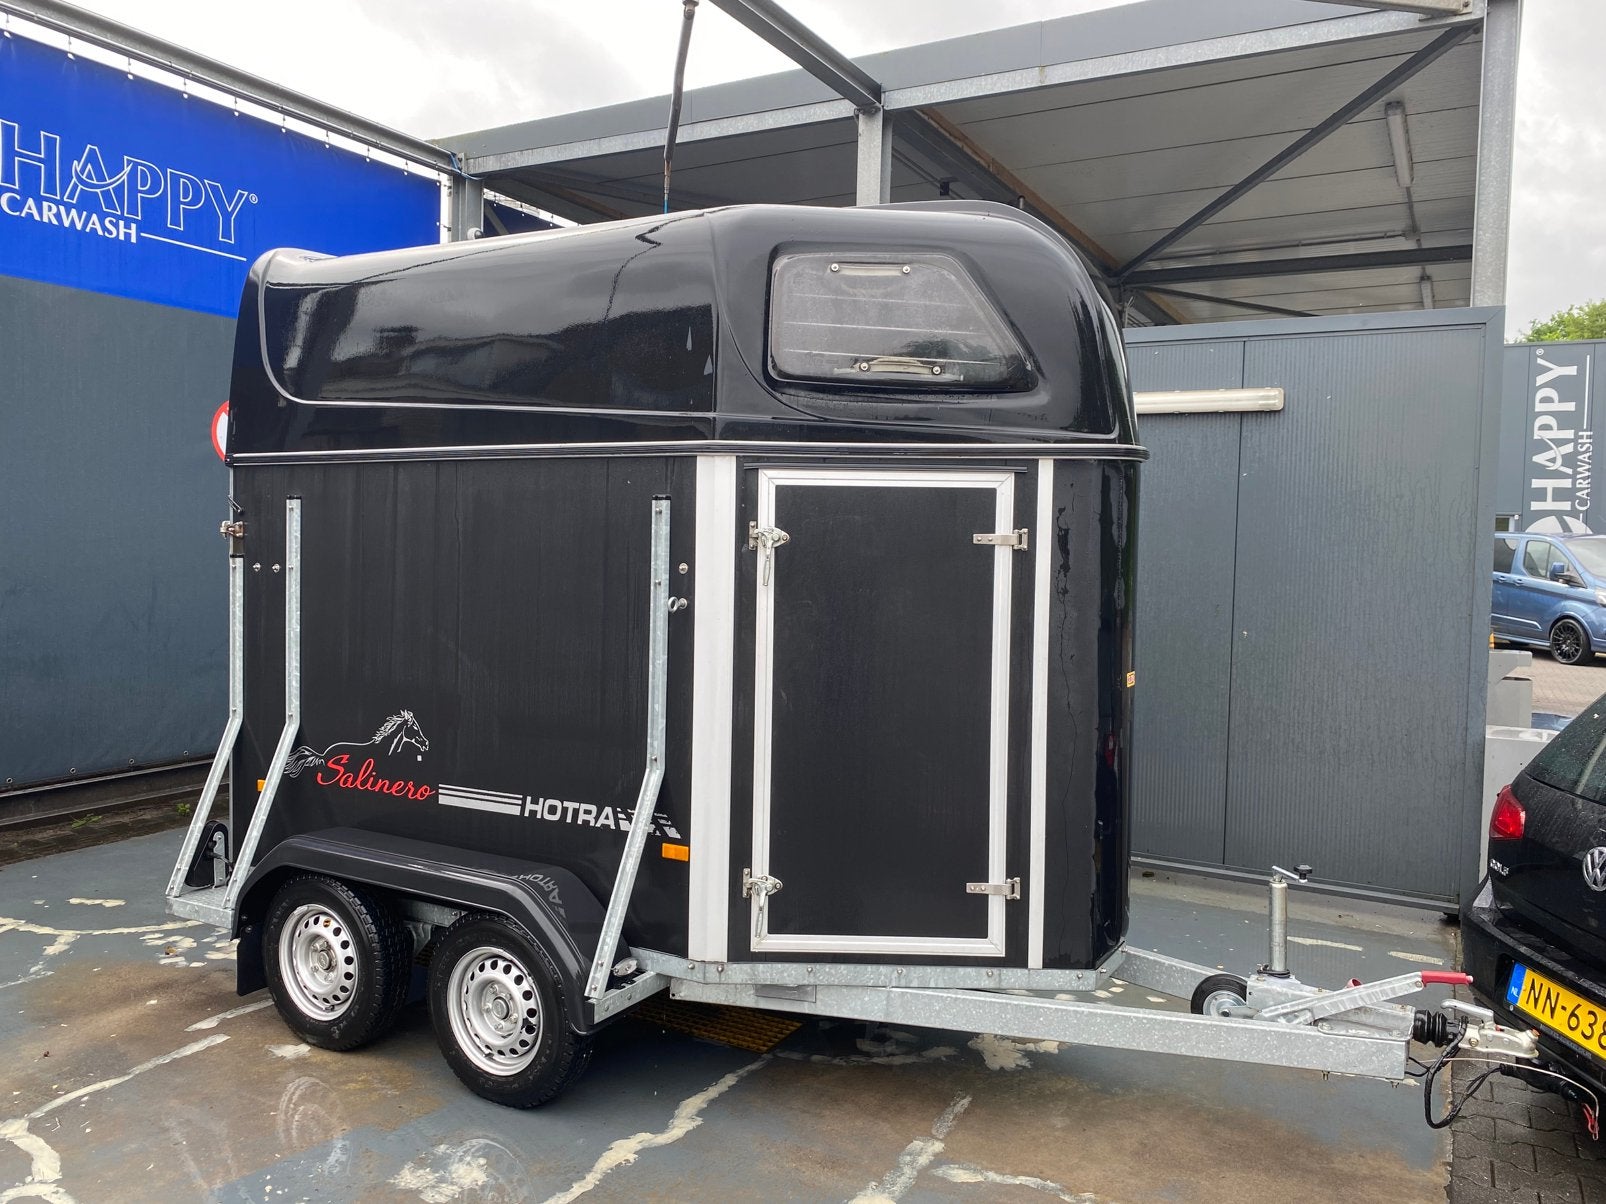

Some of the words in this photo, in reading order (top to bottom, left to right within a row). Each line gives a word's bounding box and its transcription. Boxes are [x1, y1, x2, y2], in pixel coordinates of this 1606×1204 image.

[0, 192, 137, 243] CARWASH
[1575, 431, 1593, 511] CARWASH
[316, 754, 436, 801] Salinero
[523, 796, 616, 830] HOTRA
